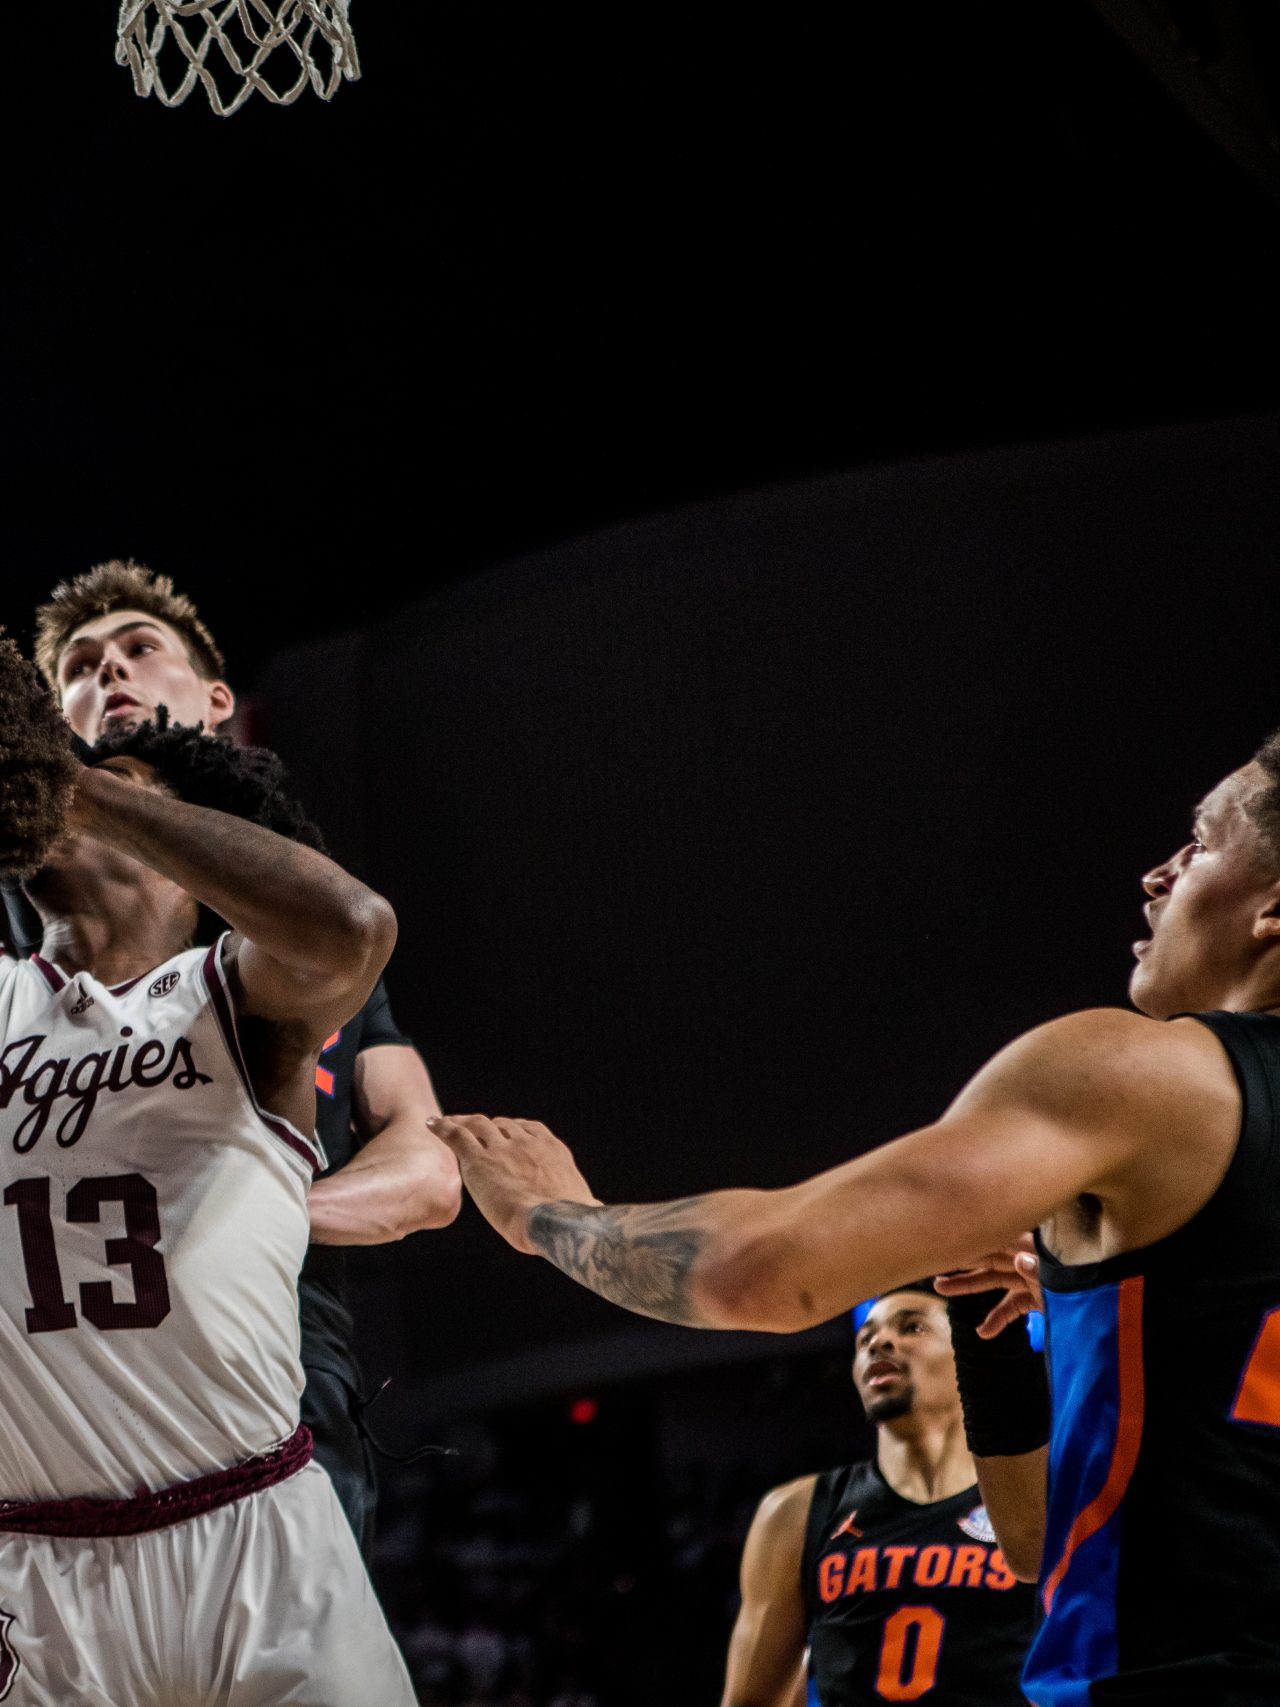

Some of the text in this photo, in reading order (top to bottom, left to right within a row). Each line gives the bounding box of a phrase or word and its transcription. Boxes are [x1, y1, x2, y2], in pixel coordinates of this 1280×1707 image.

[151, 972, 179, 996] SEC
[4, 1173, 171, 1334] 13
[819, 1543, 1017, 1604] GATORS
[875, 1604, 946, 1702] 0
